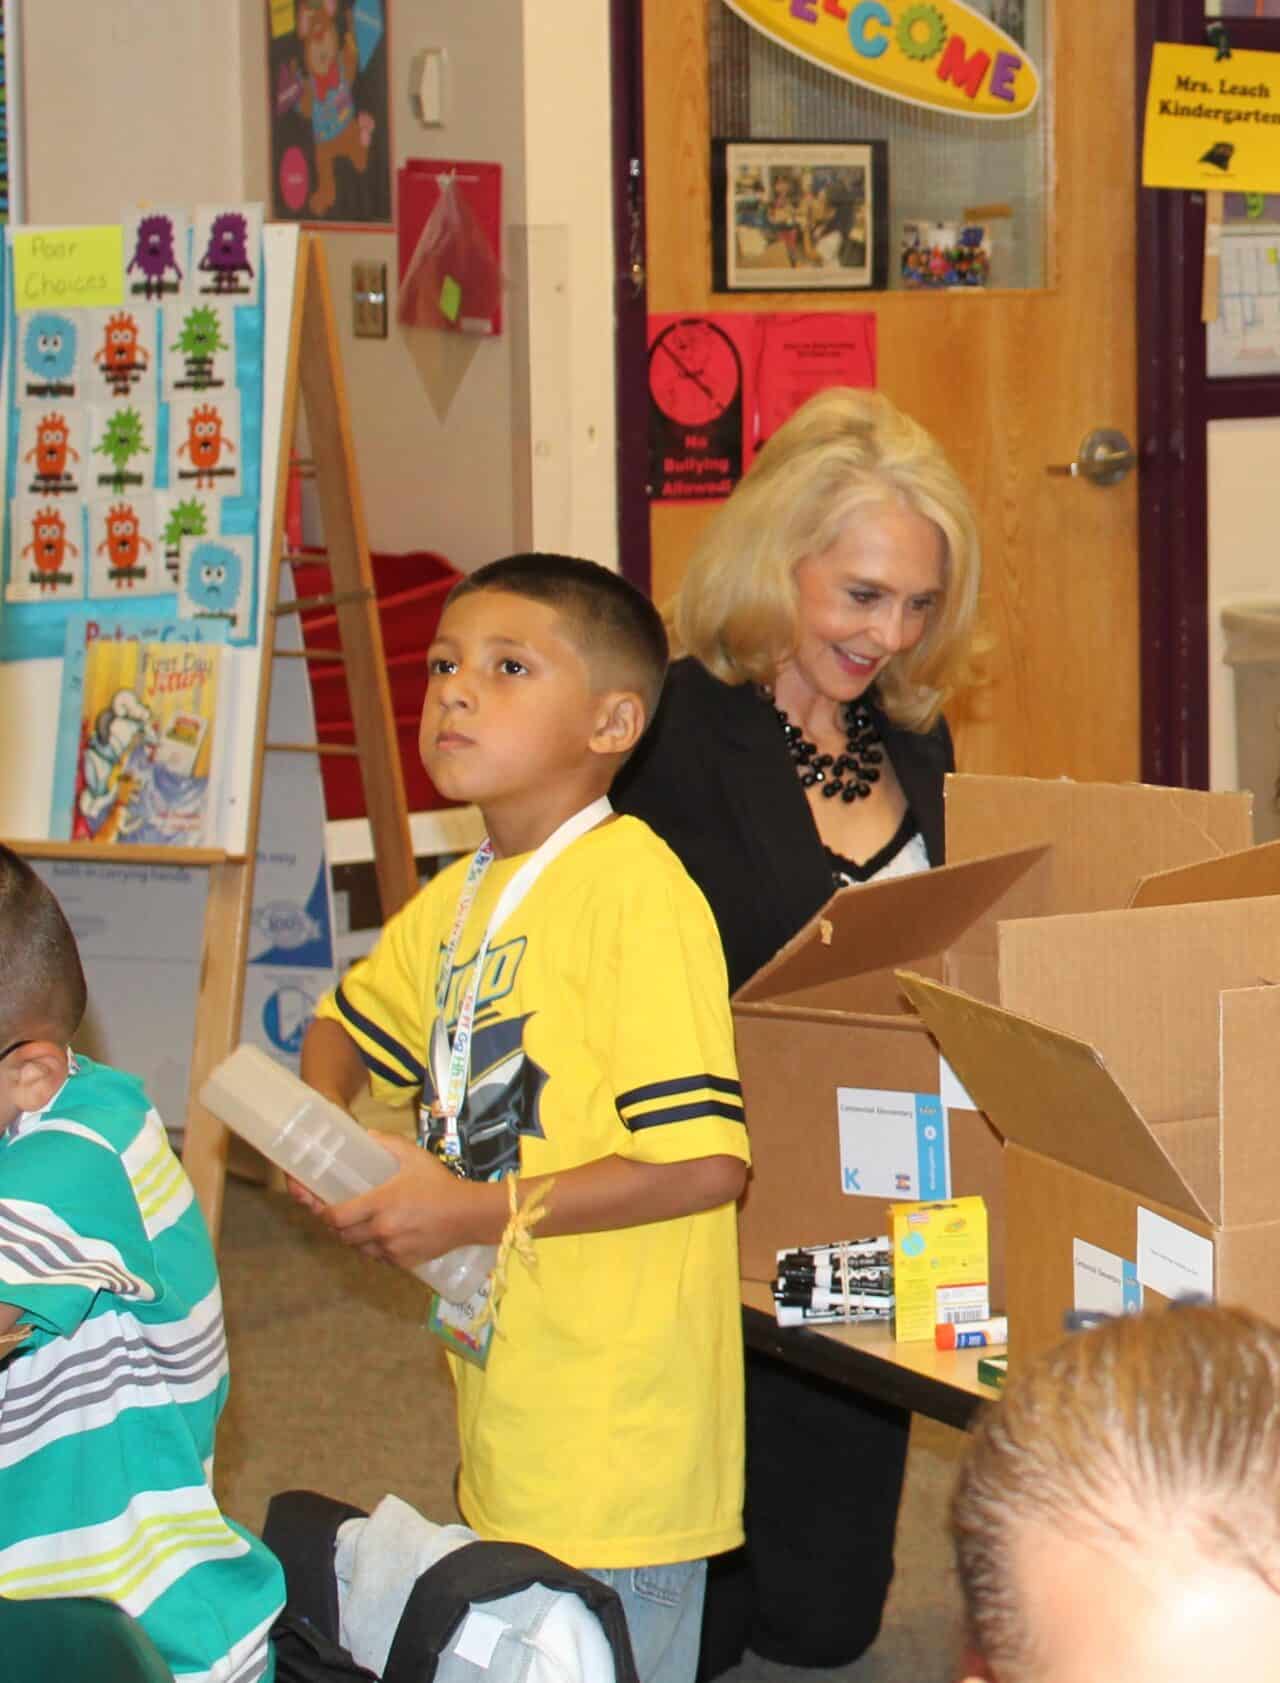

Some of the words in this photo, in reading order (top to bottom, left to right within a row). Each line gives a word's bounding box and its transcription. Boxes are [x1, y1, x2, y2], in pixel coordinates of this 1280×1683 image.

[1175, 75, 1213, 93] Mrs.
[1219, 79, 1270, 98] Leach
[31, 239, 78, 259] Poor
[24, 272, 109, 299] Choices
[685, 435, 709, 449] No
[663, 458, 729, 475] Bullying
[142, 651, 178, 674] First
[844, 1168, 861, 1190] K
